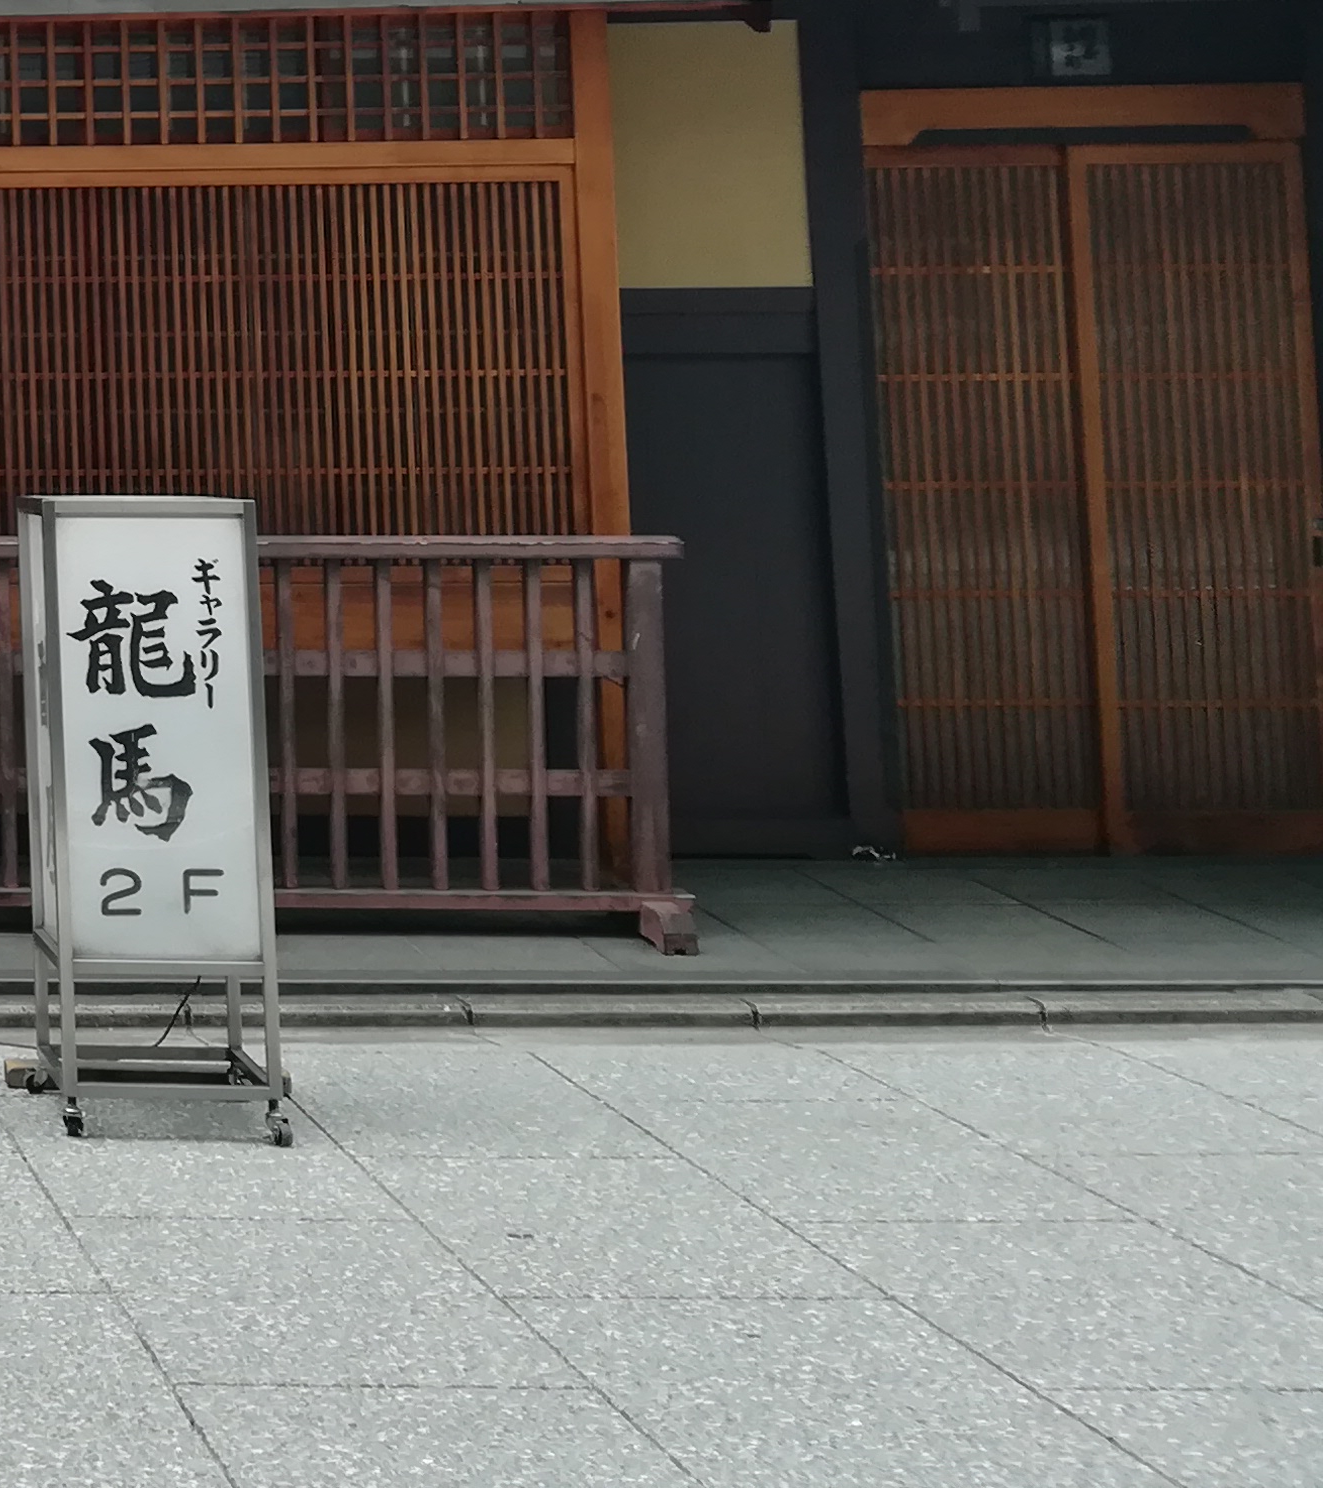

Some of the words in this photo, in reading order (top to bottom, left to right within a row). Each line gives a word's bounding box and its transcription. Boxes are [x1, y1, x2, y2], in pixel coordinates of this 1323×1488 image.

[65, 578, 197, 843] 龍馬
[190, 557, 223, 709] ギャラリー
